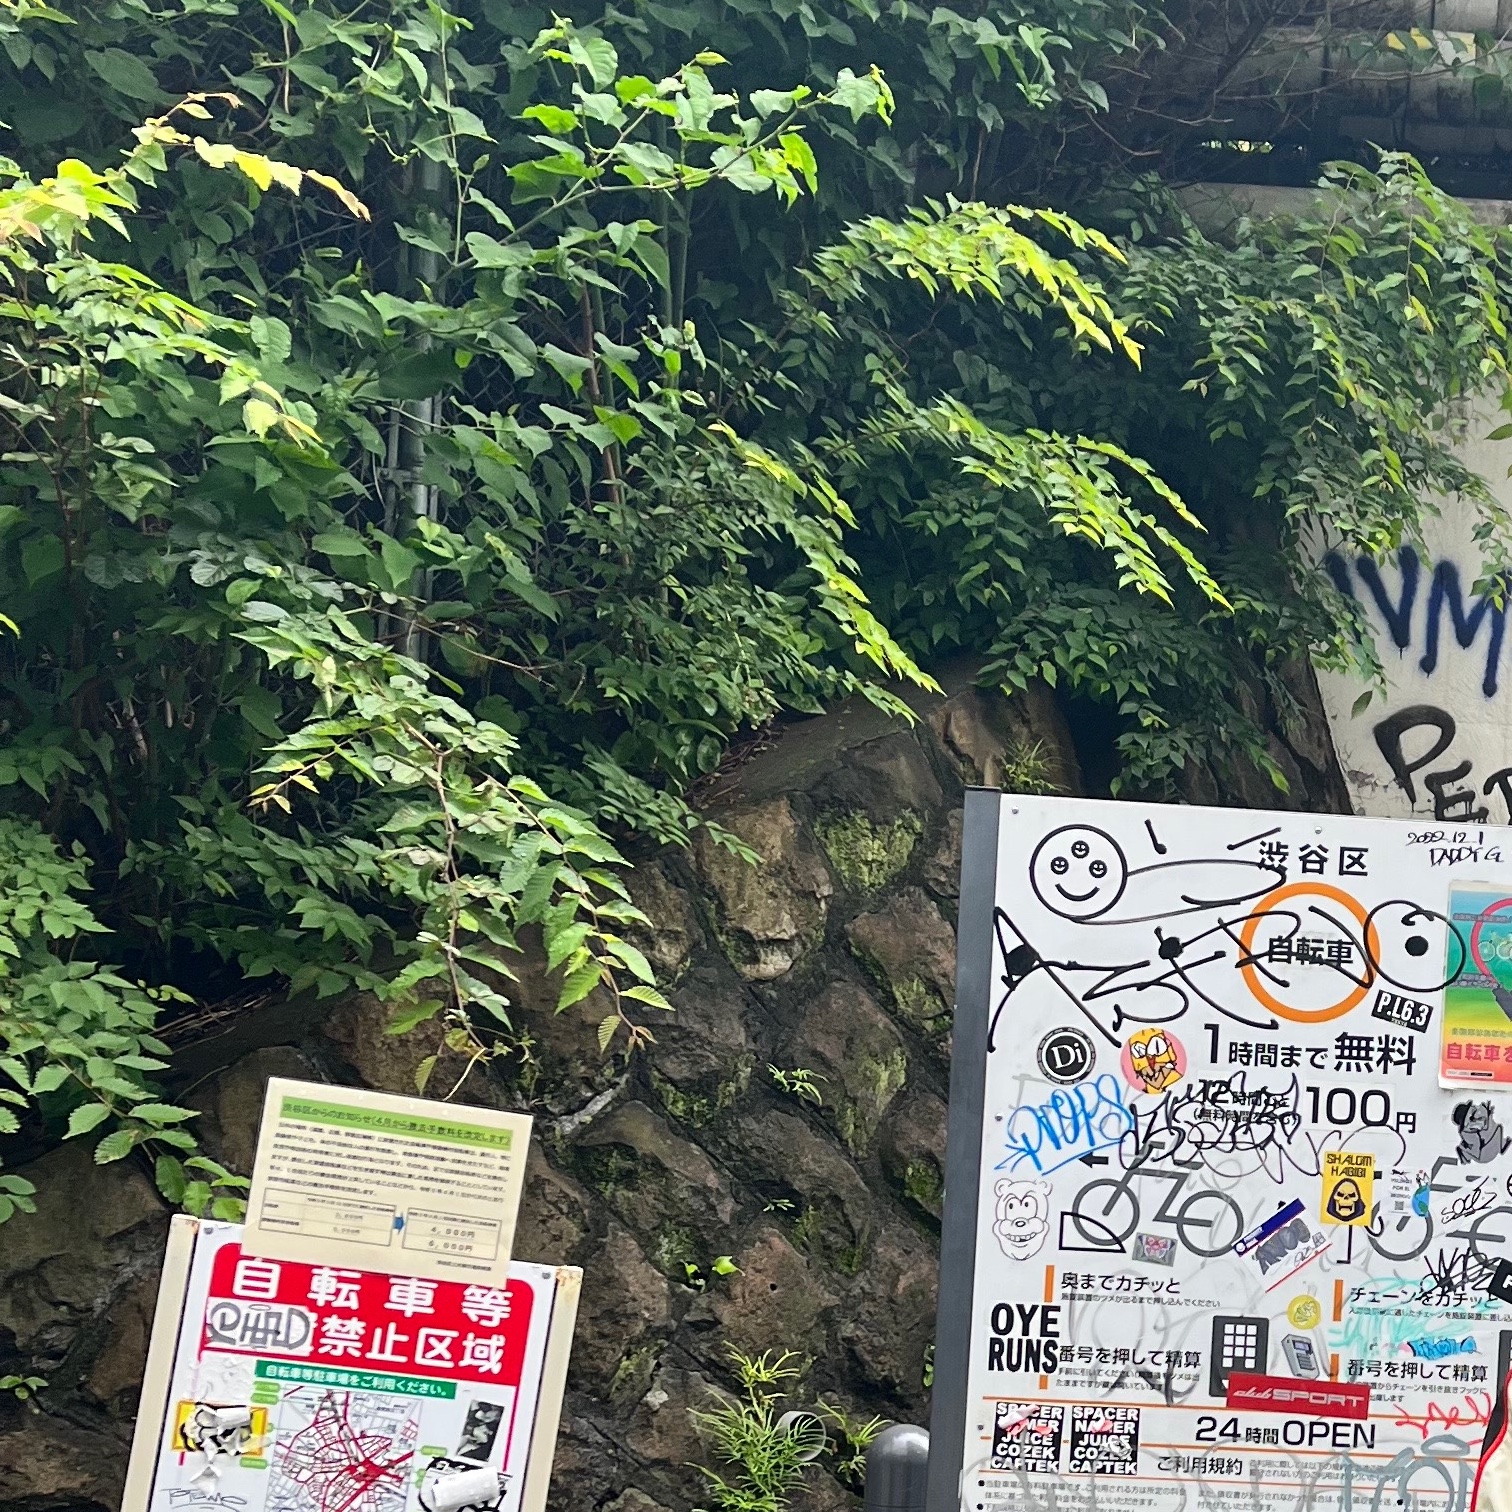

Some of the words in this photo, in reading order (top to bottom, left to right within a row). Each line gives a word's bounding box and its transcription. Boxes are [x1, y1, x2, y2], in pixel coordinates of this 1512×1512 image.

[1258, 841, 1370, 877] 渋谷区
[1268, 937, 1354, 966] 自転車
[1051, 1042, 1084, 1068] Di
[1306, 1085, 1417, 1134] 100円
[232, 1256, 513, 1328] 自転車等
[1061, 1272, 1181, 1295] 奥までカチッと
[990, 1303, 1062, 1338] OYE
[314, 1316, 506, 1375] 禁止区域
[987, 1337, 1058, 1373] RUNS
[1059, 1345, 1202, 1369] 番号を押して精算
[1347, 1358, 1489, 1383] 番号を押して精算
[1271, 1388, 1365, 1408] SPORT
[1073, 1406, 1139, 1421] SPACER
[1001, 1432, 1054, 1445] JUICE
[1282, 1420, 1376, 1449] OPEN
[991, 1456, 1059, 1473] CAPTEK
[995, 1443, 1056, 1460] COZEK
[1069, 1459, 1137, 1475] CAPTEK
[1157, 1456, 1243, 1476] ご利用規約
